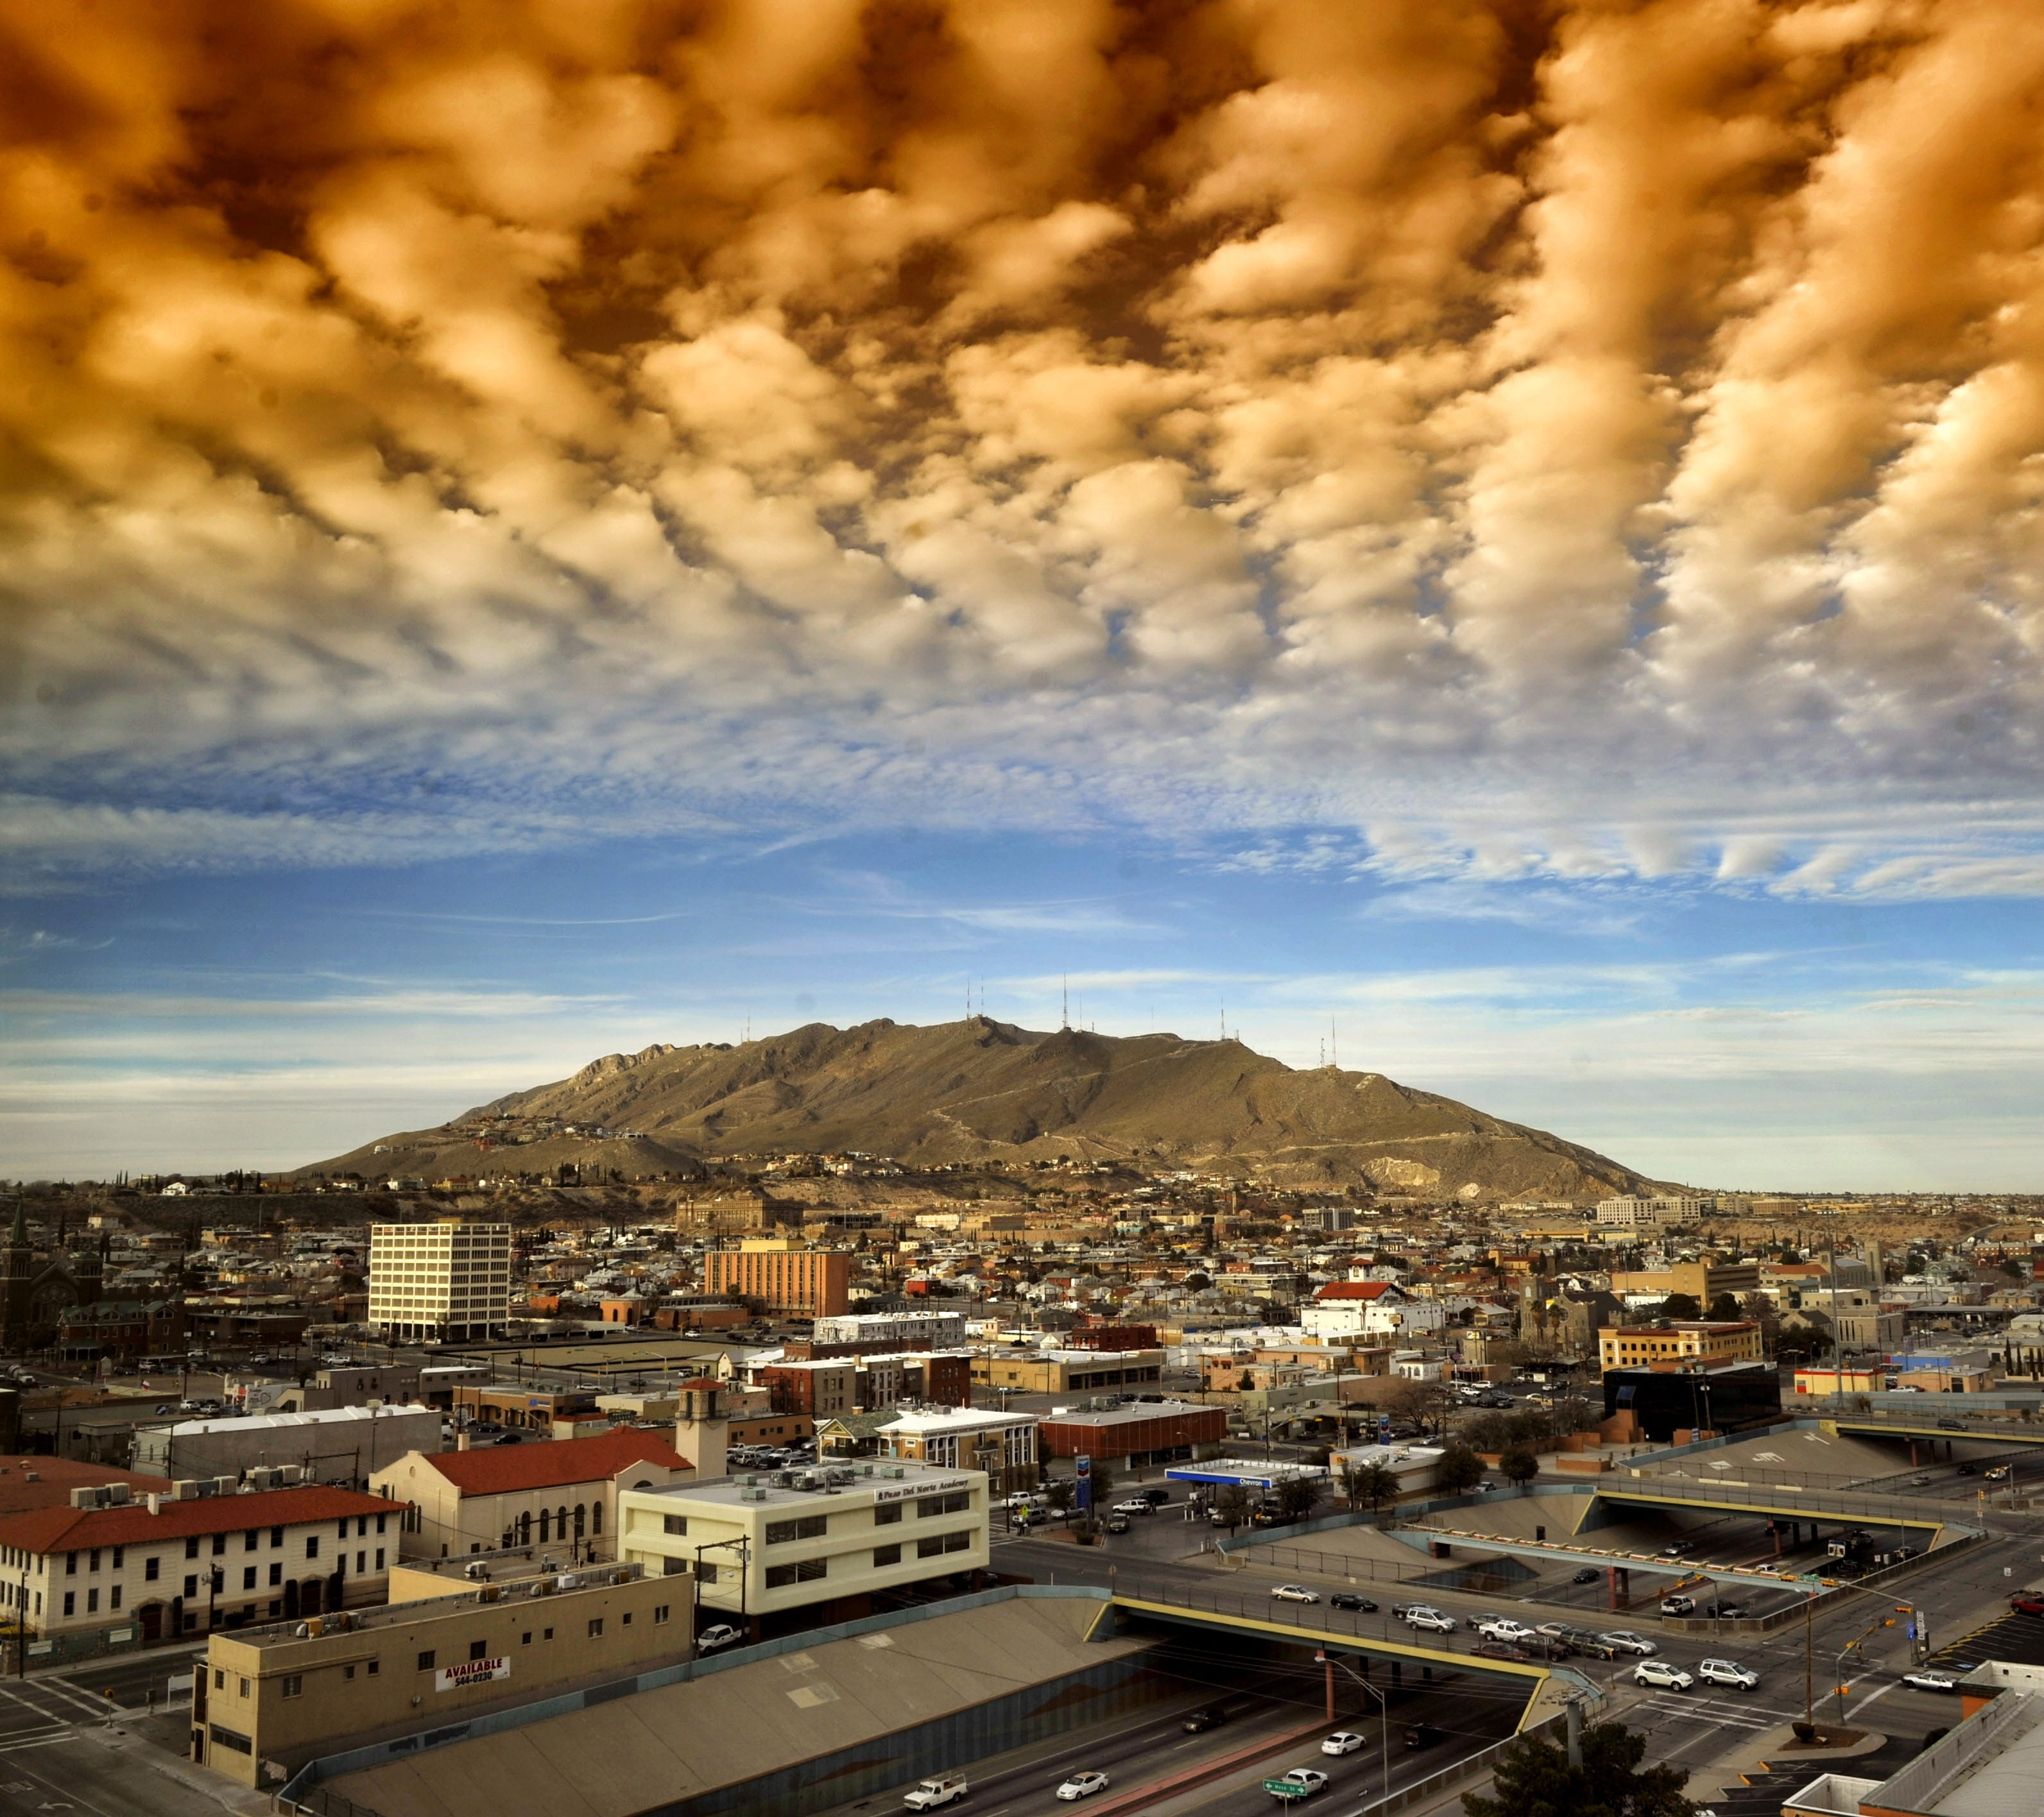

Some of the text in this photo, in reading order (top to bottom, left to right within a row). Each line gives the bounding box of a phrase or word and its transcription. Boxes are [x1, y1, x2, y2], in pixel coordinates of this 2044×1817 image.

[884, 1479, 969, 1499] Paso Del Norte Academy
[1239, 1478, 1263, 1487] Chevron
[445, 1659, 502, 1679] AVAILABLE
[454, 1671, 493, 1687] 544-0230
